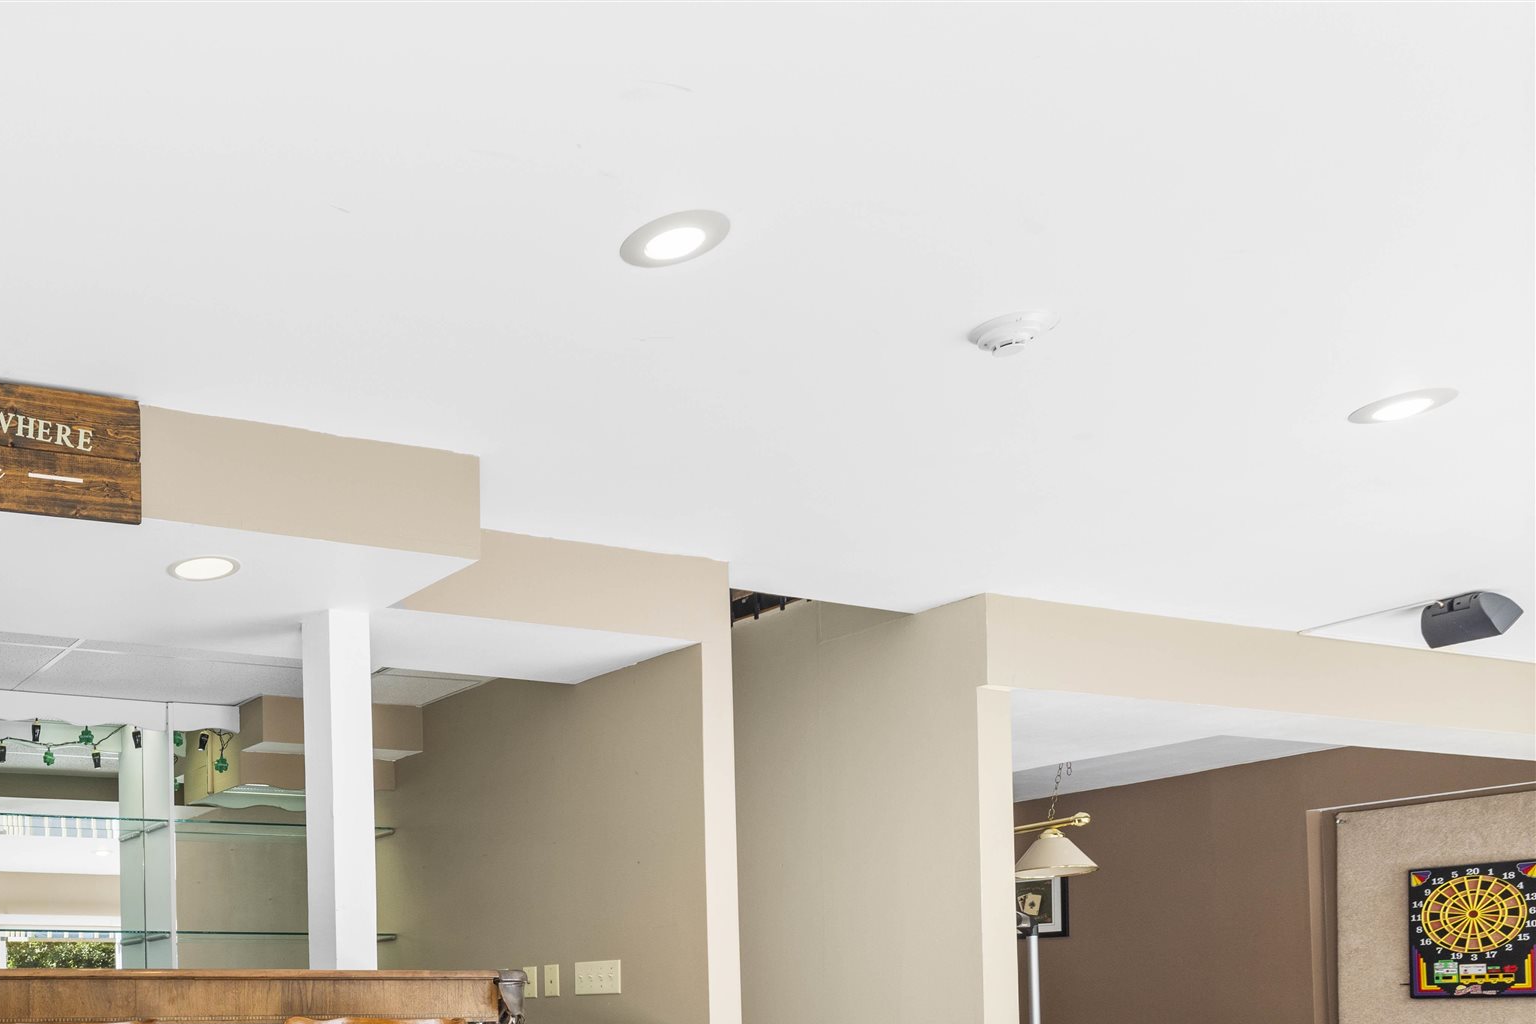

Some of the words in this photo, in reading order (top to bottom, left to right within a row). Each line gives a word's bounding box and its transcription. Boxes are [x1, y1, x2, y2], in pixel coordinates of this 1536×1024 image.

[1451, 870, 1459, 879] 5
[1465, 867, 1480, 876] 20
[1487, 868, 1494, 876] 1
[1502, 871, 1516, 880] 18
[1431, 877, 1444, 886] 12
[1516, 881, 1524, 890] 4
[1424, 888, 1432, 897] 9
[1412, 900, 1424, 909] 14
[1410, 914, 1422, 922] 11
[1415, 926, 1423, 934] 8
[1517, 932, 1531, 941] 15
[1419, 938, 1433, 946] 16
[1435, 946, 1443, 954] 7
[1505, 943, 1513, 952] 2
[1450, 952, 1464, 960] 19
[1470, 953, 1478, 961] 3
[1484, 951, 1498, 959] 17
